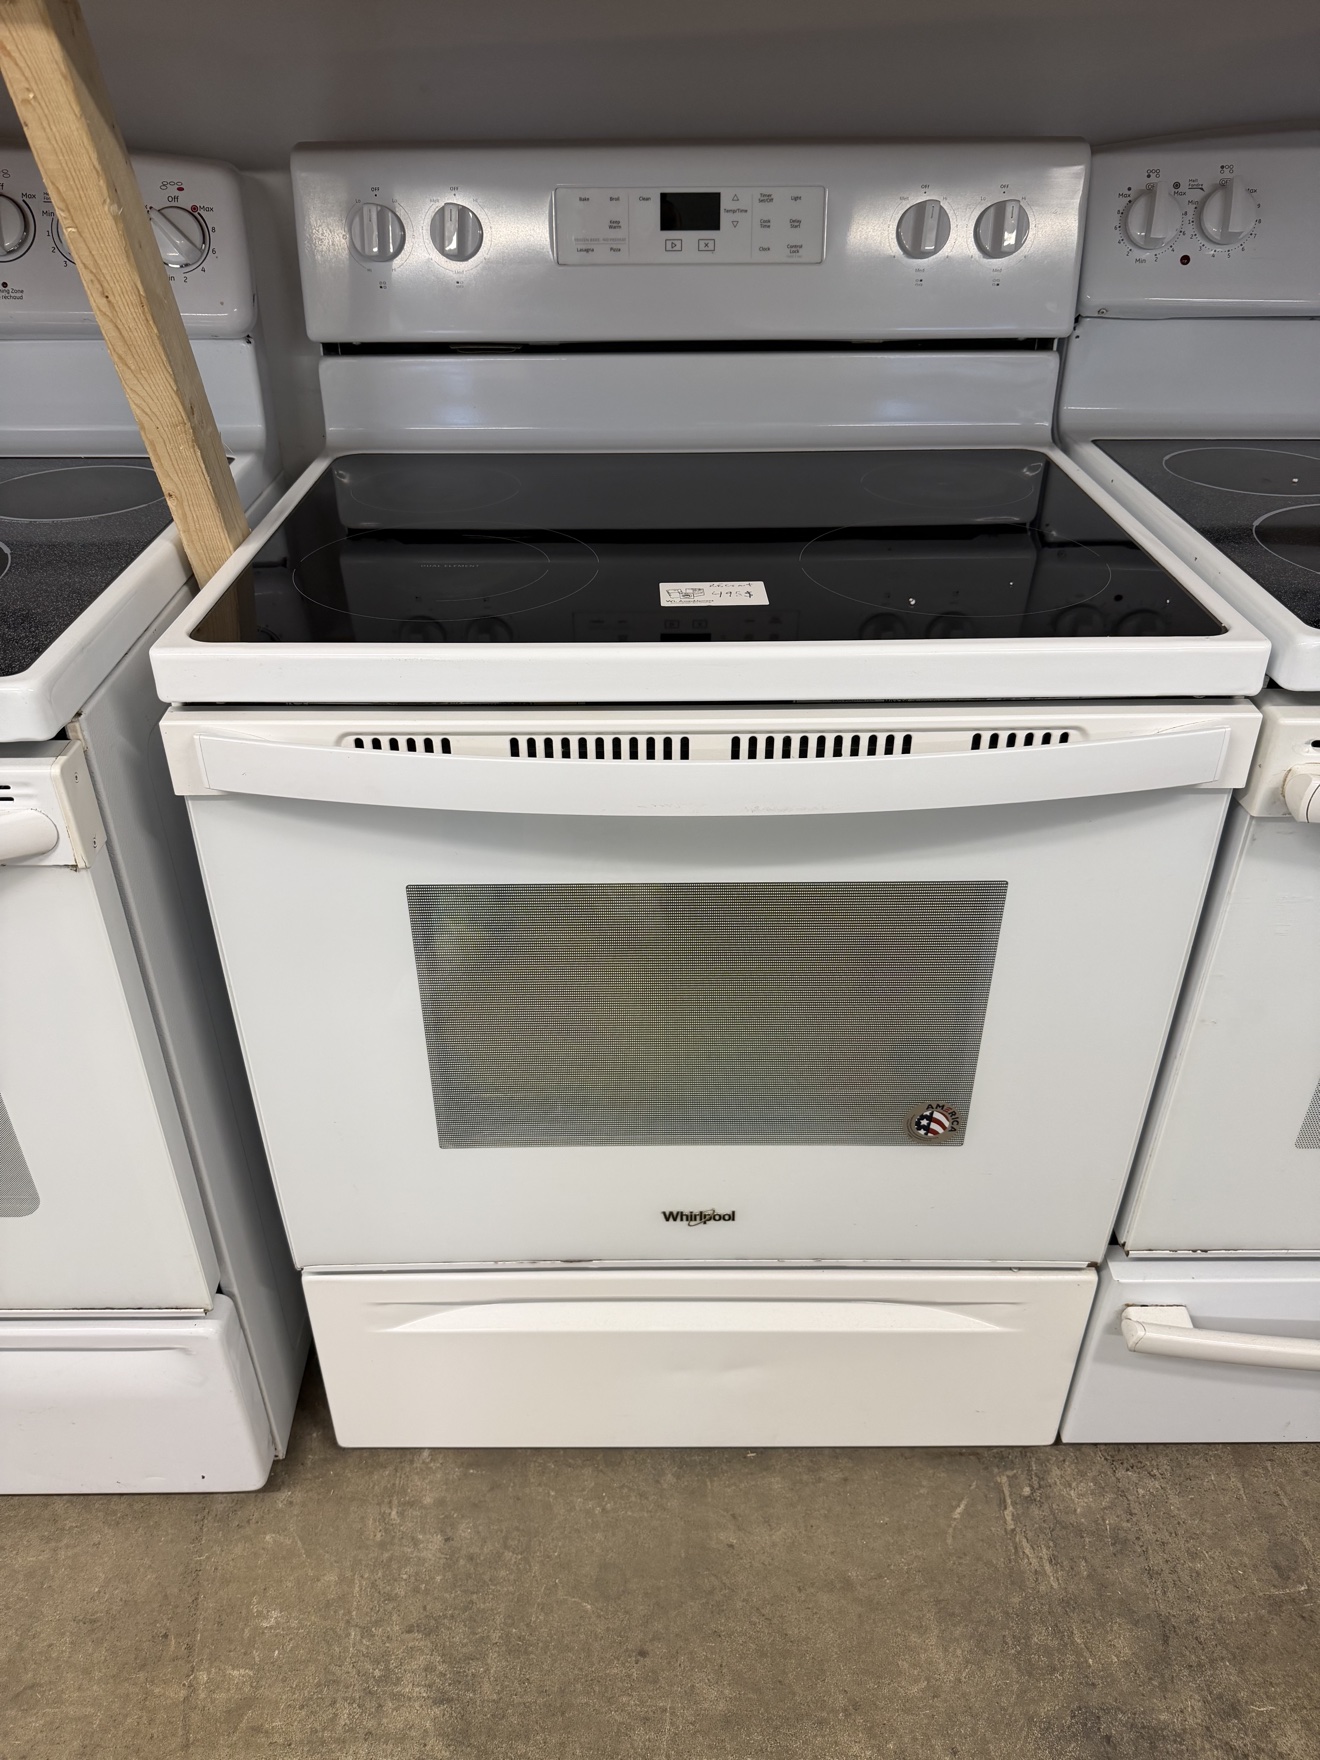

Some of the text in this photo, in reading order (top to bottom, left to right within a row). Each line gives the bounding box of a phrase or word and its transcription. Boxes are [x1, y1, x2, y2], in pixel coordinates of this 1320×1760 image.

[167, 195, 179, 203] Off
[198, 205, 214, 213] Max
[926, 1103, 959, 1132] AMERICA
[661, 1208, 736, 1226] Whirlpool
